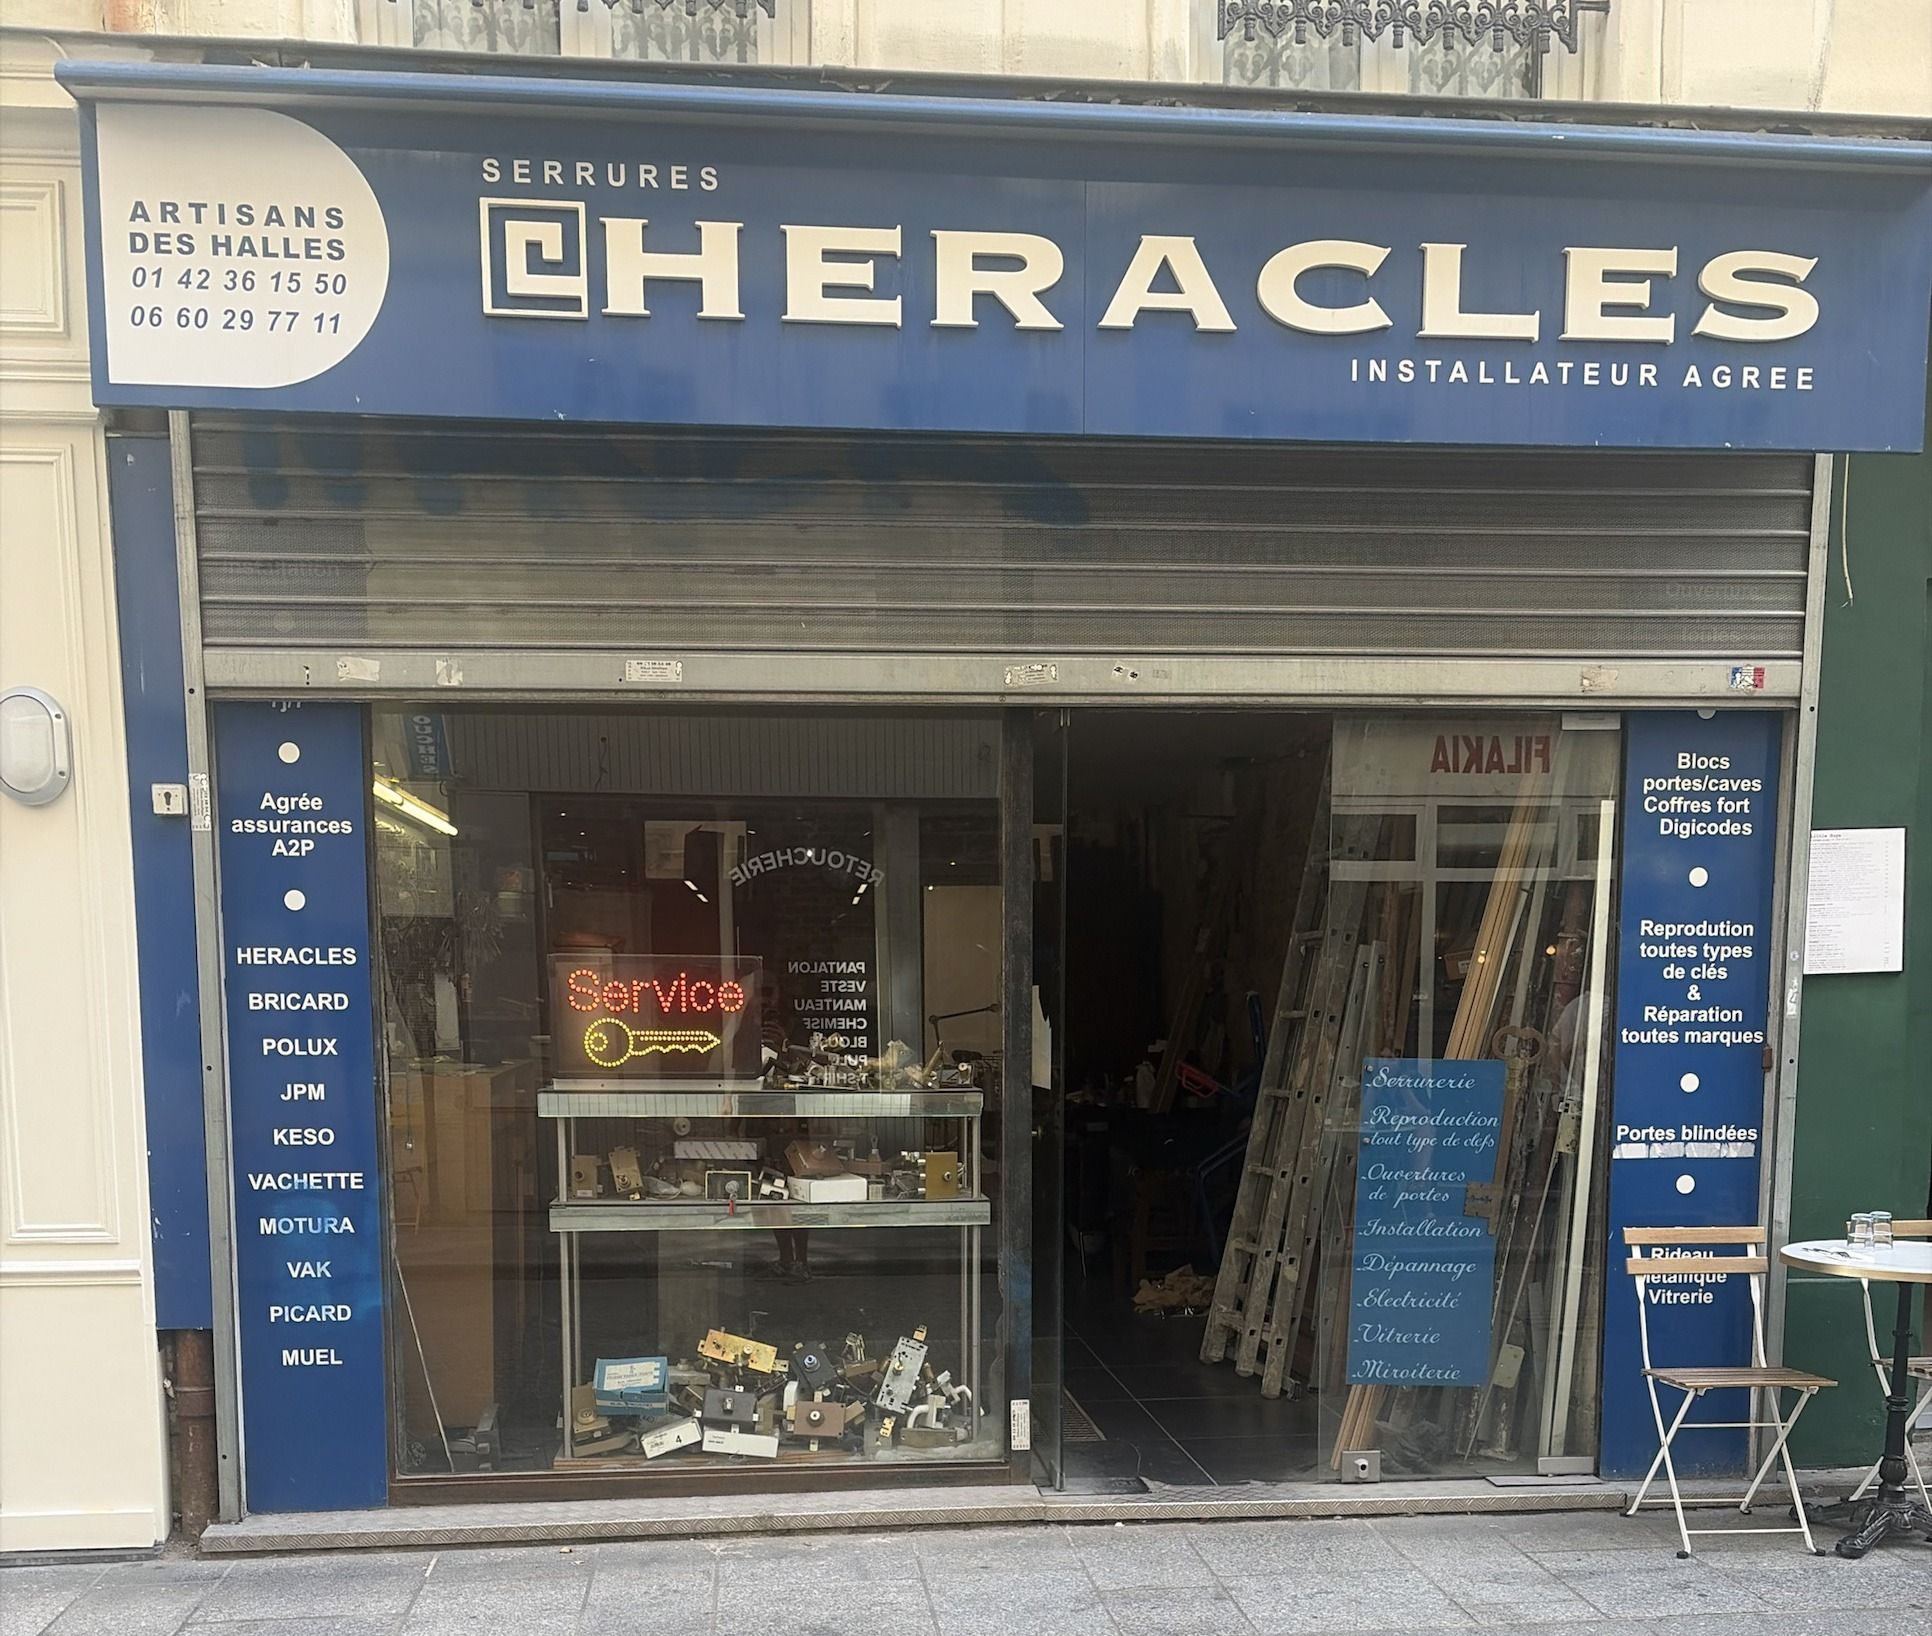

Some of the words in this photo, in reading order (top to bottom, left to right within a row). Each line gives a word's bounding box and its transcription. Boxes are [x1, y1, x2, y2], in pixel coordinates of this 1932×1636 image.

[481, 157, 719, 192] SERRURES
[128, 200, 346, 230] ARTISANS
[128, 232, 196, 256] DES
[211, 234, 346, 262] HALLES
[131, 266, 164, 290] 01
[177, 268, 211, 291] 42
[223, 269, 256, 293] 36
[270, 271, 302, 294] 15
[314, 272, 348, 296] 50
[599, 216, 1820, 346] HERACLES
[129, 305, 163, 328] 06
[175, 306, 209, 330] 60
[222, 308, 254, 332] 29
[267, 310, 300, 333] 77
[314, 312, 342, 335] 11
[1350, 358, 1658, 388] INSTALLATEUR
[1682, 363, 1816, 391] AGREE
[1677, 752, 1730, 770] Blocs
[1642, 775, 1762, 794] portes/caves
[260, 792, 323, 815] Agrée
[1643, 796, 1712, 814] Coffres
[1716, 796, 1750, 814] fort
[231, 818, 353, 835] assurances
[1659, 818, 1753, 840] Digicodes
[271, 839, 315, 857] A2P
[1640, 919, 1755, 940] Reprodution
[236, 947, 357, 966] HERACLES
[1639, 942, 1698, 959] toutes
[1703, 942, 1753, 963] types
[1662, 963, 1686, 980] de
[1690, 963, 1728, 980] clés
[567, 968, 745, 1014] Service
[1686, 984, 1702, 1002] &
[247, 992, 350, 1012] BRICARD
[1643, 1005, 1743, 1026] Réparation
[261, 1038, 338, 1057] POLUX
[1621, 1027, 1680, 1044] toutes
[1684, 1029, 1764, 1048] marques
[1371, 1066, 1476, 1089] Serrurerie
[280, 1083, 326, 1101] JPM
[1369, 1105, 1500, 1132] Reproduction
[272, 1127, 335, 1146] KESO
[1370, 1131, 1402, 1146] tout
[1406, 1132, 1438, 1153] type
[1442, 1132, 1461, 1147] de
[1463, 1132, 1495, 1154] clefs
[1616, 1125, 1676, 1142] Portes
[1681, 1124, 1758, 1141] blindées
[247, 1172, 364, 1191] VACHETTE
[1367, 1163, 1466, 1182] Ouvertures
[1368, 1185, 1387, 1201] de
[1393, 1187, 1450, 1209] portes
[259, 1216, 355, 1235] MOTURA
[1363, 1217, 1483, 1238] Installation
[286, 1261, 332, 1279] VAK
[1362, 1252, 1477, 1282] Dépannage
[1648, 1288, 1714, 1305] Vitrerie
[269, 1304, 352, 1323] PICARD
[1358, 1323, 1441, 1344] Vitrerie
[281, 1348, 343, 1366] MUEL
[1357, 1359, 1461, 1380] Miroiterie
